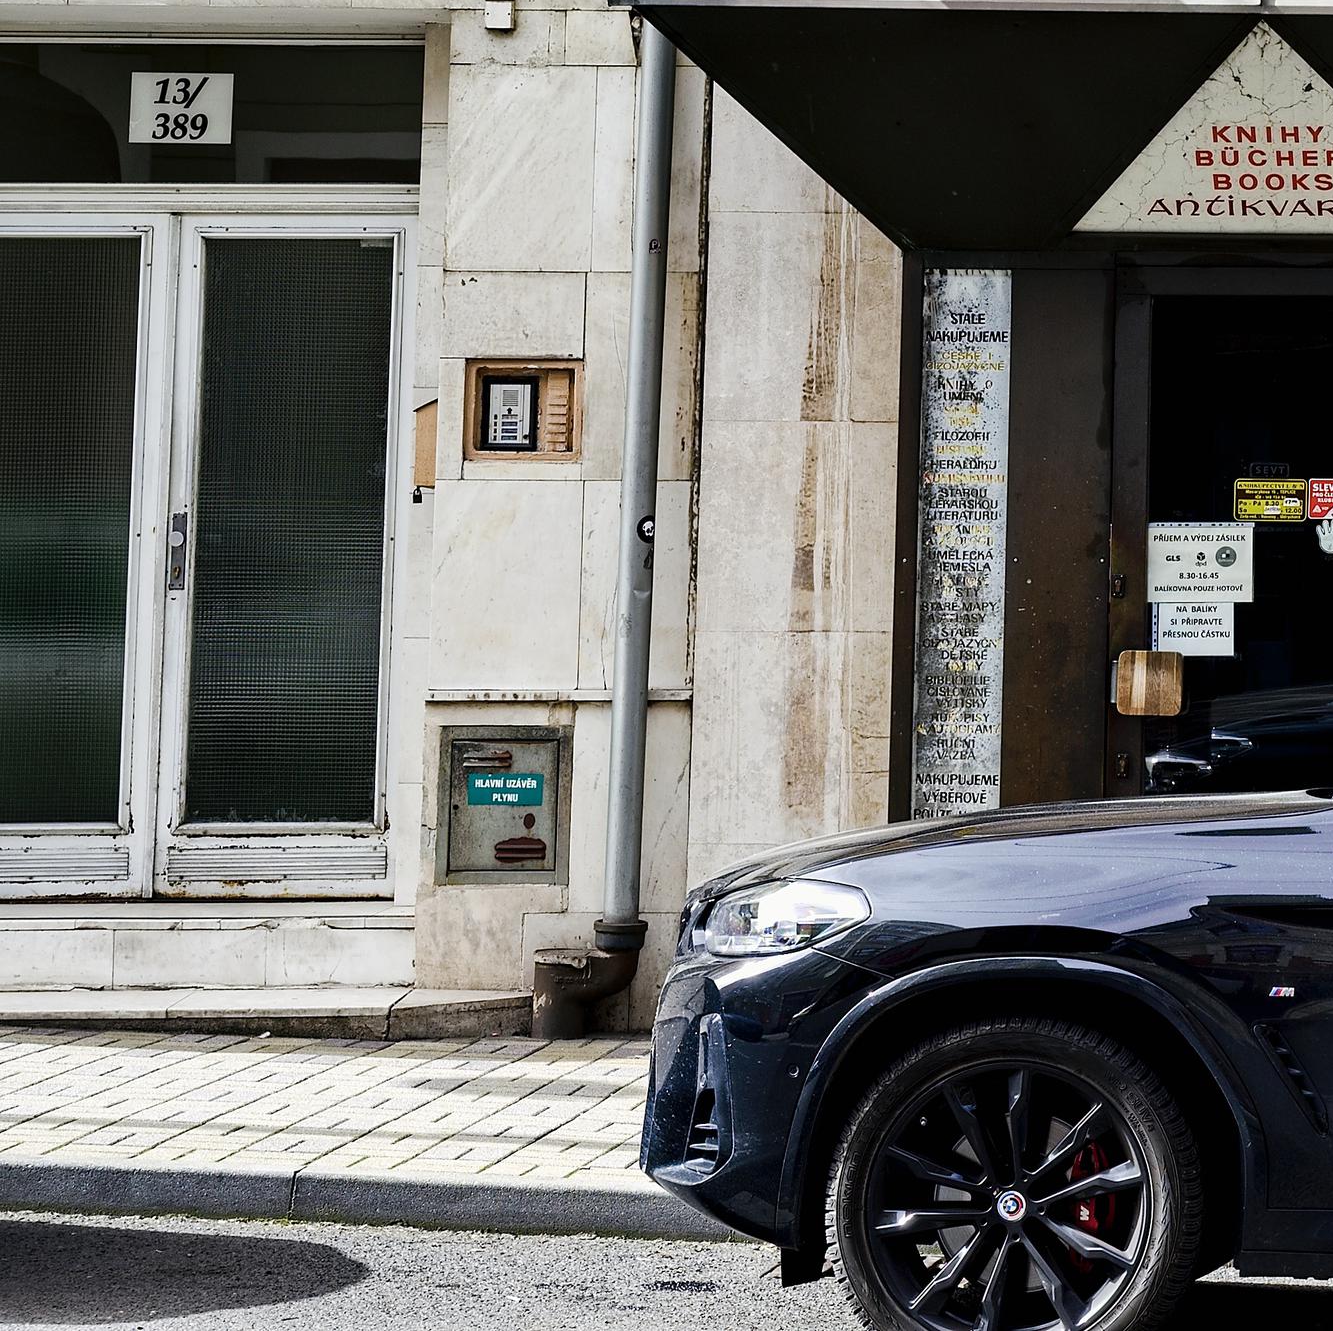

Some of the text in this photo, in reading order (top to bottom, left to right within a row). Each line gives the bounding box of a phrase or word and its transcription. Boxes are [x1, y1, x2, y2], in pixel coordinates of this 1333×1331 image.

[153, 76, 210, 109] 13/
[151, 112, 209, 140] 389
[1211, 125, 1325, 145] KNIHY
[1212, 172, 1333, 192] BOOKS
[925, 330, 1009, 343] NAKUPUJEME
[930, 459, 997, 469] HERALDIKU
[926, 510, 999, 521] LITERATURU
[1153, 534, 1181, 542] PŘÍJEM
[1191, 534, 1214, 542] VÝDEJ
[1216, 534, 1246, 542] ZÁSILEK
[962, 601, 998, 612] MAPY
[1191, 605, 1218, 613] BALÍKY
[1181, 617, 1222, 625] PŘIPRAVTE
[1162, 629, 1231, 638] PŘESNOU ČÁSTKU
[475, 776, 537, 789] HLAVNÍ UZÁVĚR
[915, 773, 999, 786] NAKUPUJEME
[492, 793, 518, 802] PLYNU
[923, 788, 987, 804] VÝBĚROVĚ
